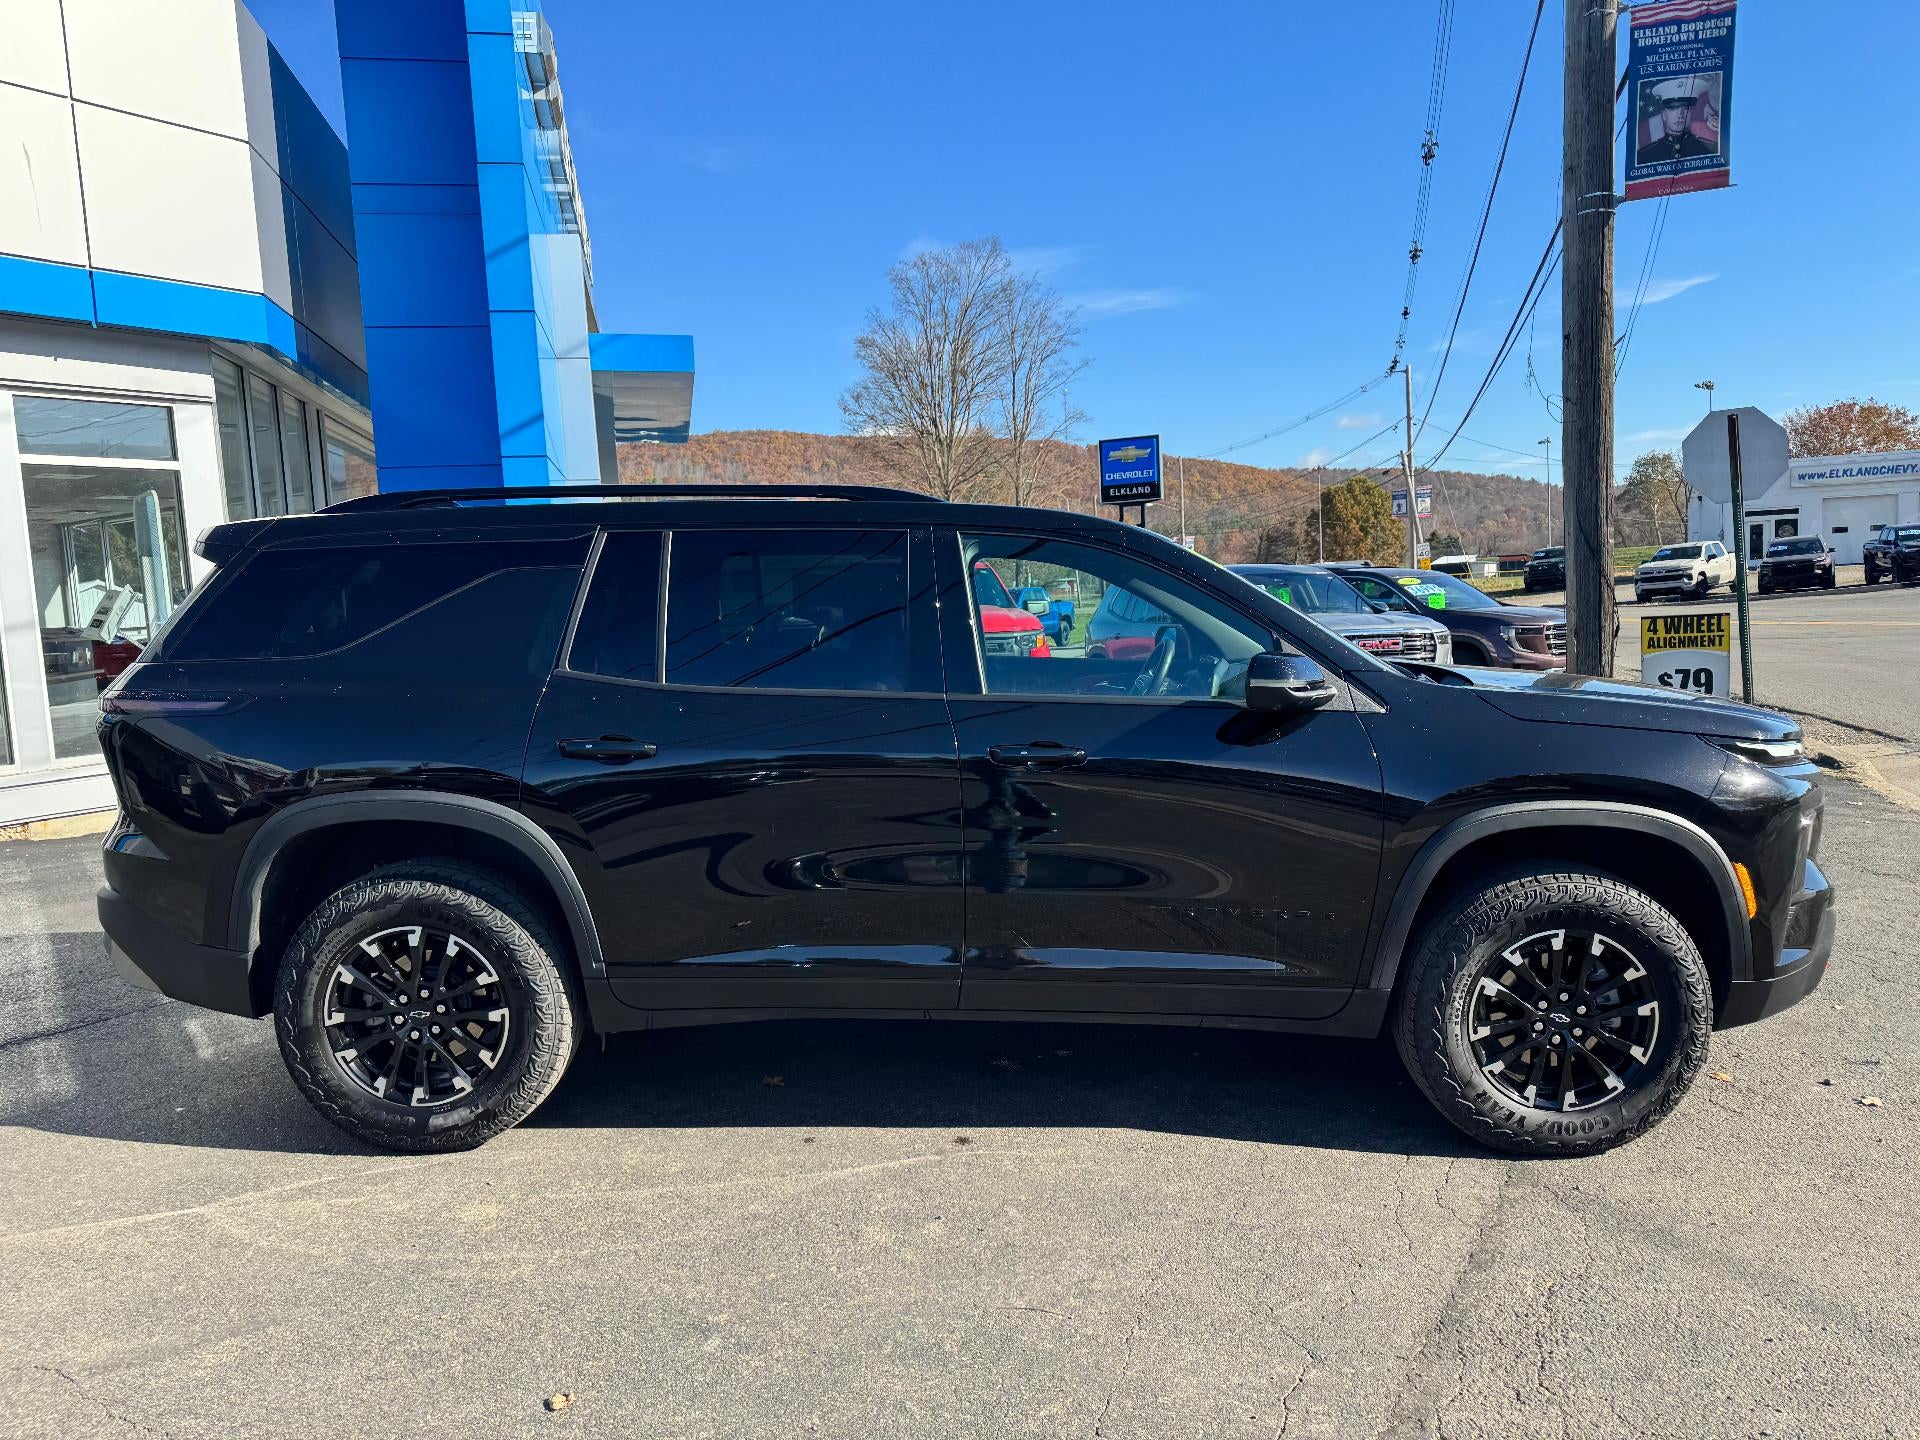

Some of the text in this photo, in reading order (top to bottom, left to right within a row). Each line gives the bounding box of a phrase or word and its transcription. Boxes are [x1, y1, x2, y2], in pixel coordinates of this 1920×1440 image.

[1634, 16, 1732, 39] ELKLAND BOROUGH
[1638, 27, 1727, 47] HOMETOWN HERO
[1646, 47, 1718, 63] MICHAEL PLANK
[1656, 61, 1691, 72] MARINE
[1693, 57, 1722, 68] CORPS
[1630, 166, 1656, 177] GLOBAL
[1656, 164, 1671, 173] WAR
[1105, 469, 1154, 480] CHEVROLET
[1110, 485, 1151, 496] ELKLAND
[1647, 615, 1724, 635] 4 WHEEL
[1358, 639, 1400, 650] GMC
[1647, 634, 1724, 649] ALIGNMENT
[1658, 668, 1713, 695] $79
